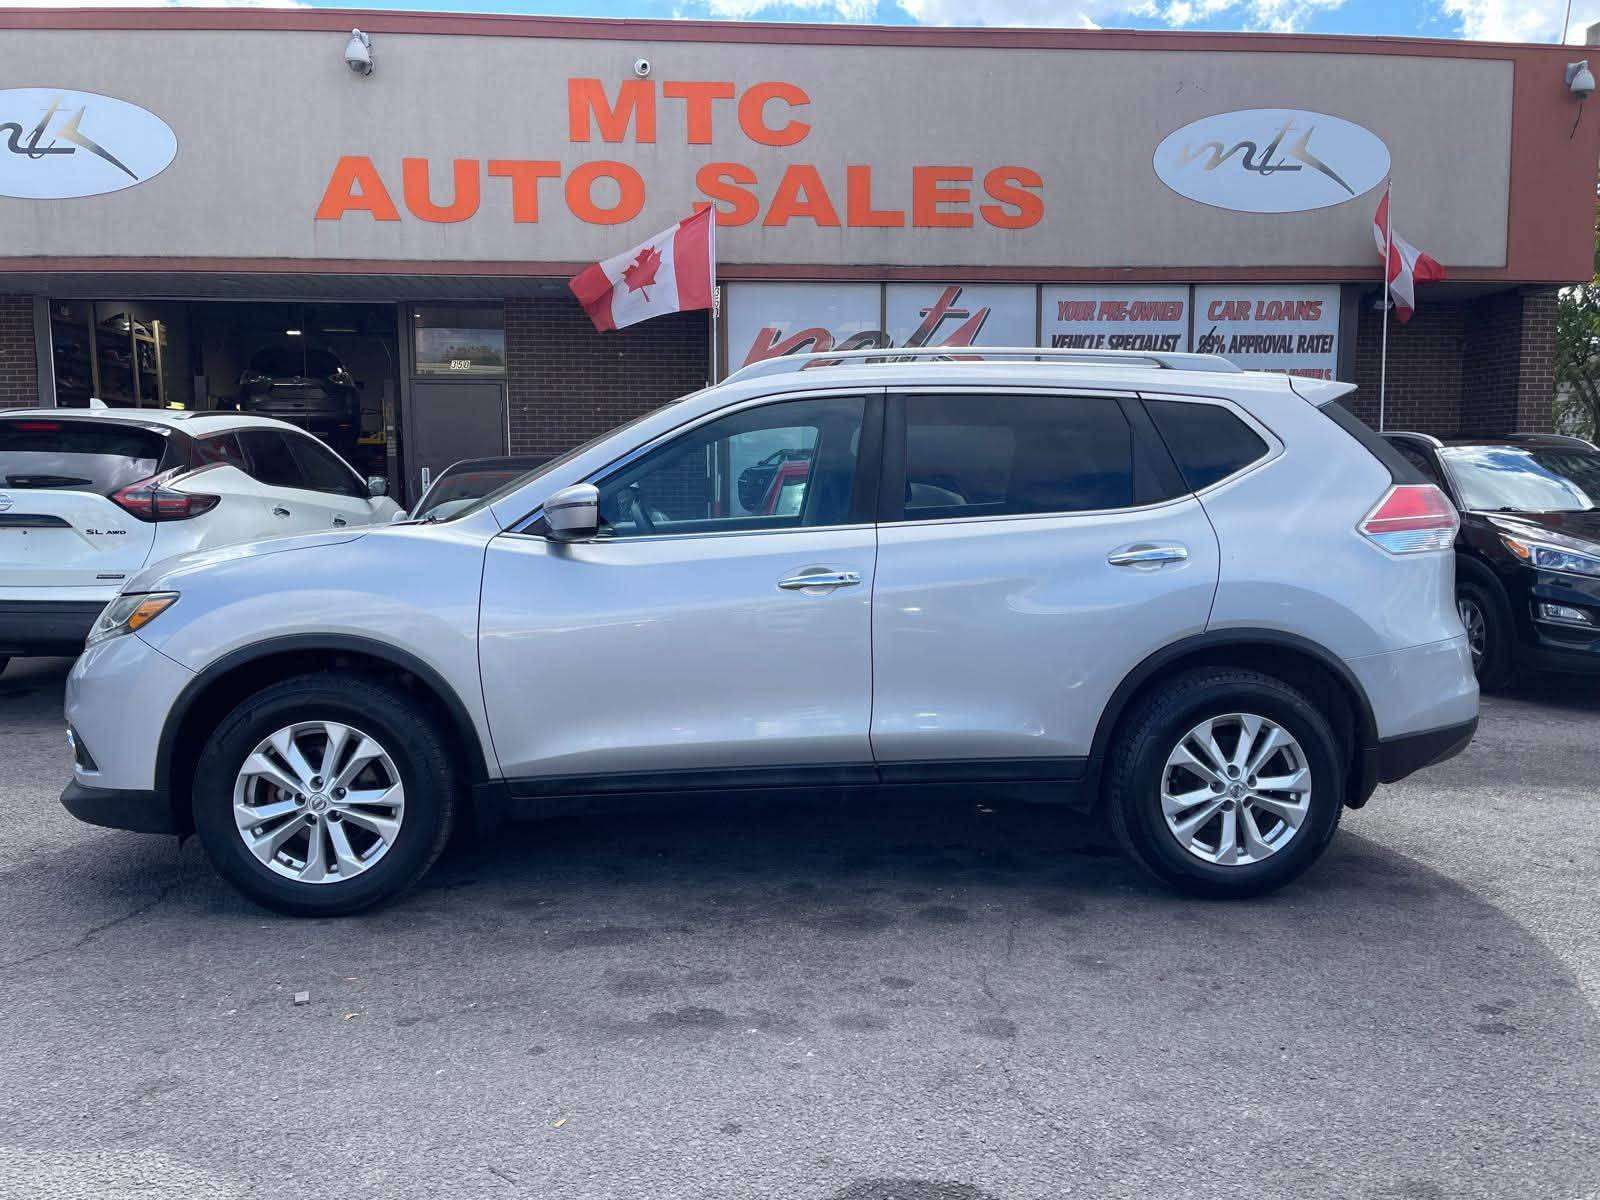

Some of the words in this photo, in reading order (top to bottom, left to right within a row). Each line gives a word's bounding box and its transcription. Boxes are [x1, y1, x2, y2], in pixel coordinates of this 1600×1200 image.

[567, 77, 812, 147] MTC
[313, 155, 647, 225] AUTO
[693, 162, 1046, 229] SALES
[1058, 301, 1097, 321] YOUR
[1097, 301, 1184, 321] PRE-OWNED
[1207, 301, 1252, 321] CAR
[1254, 301, 1323, 321] LOANS
[1051, 335, 1106, 351] VEHICLE
[1107, 334, 1182, 353] SPECIALIST
[1228, 335, 1294, 353] APPROVAL
[1296, 335, 1335, 353] RATE!
